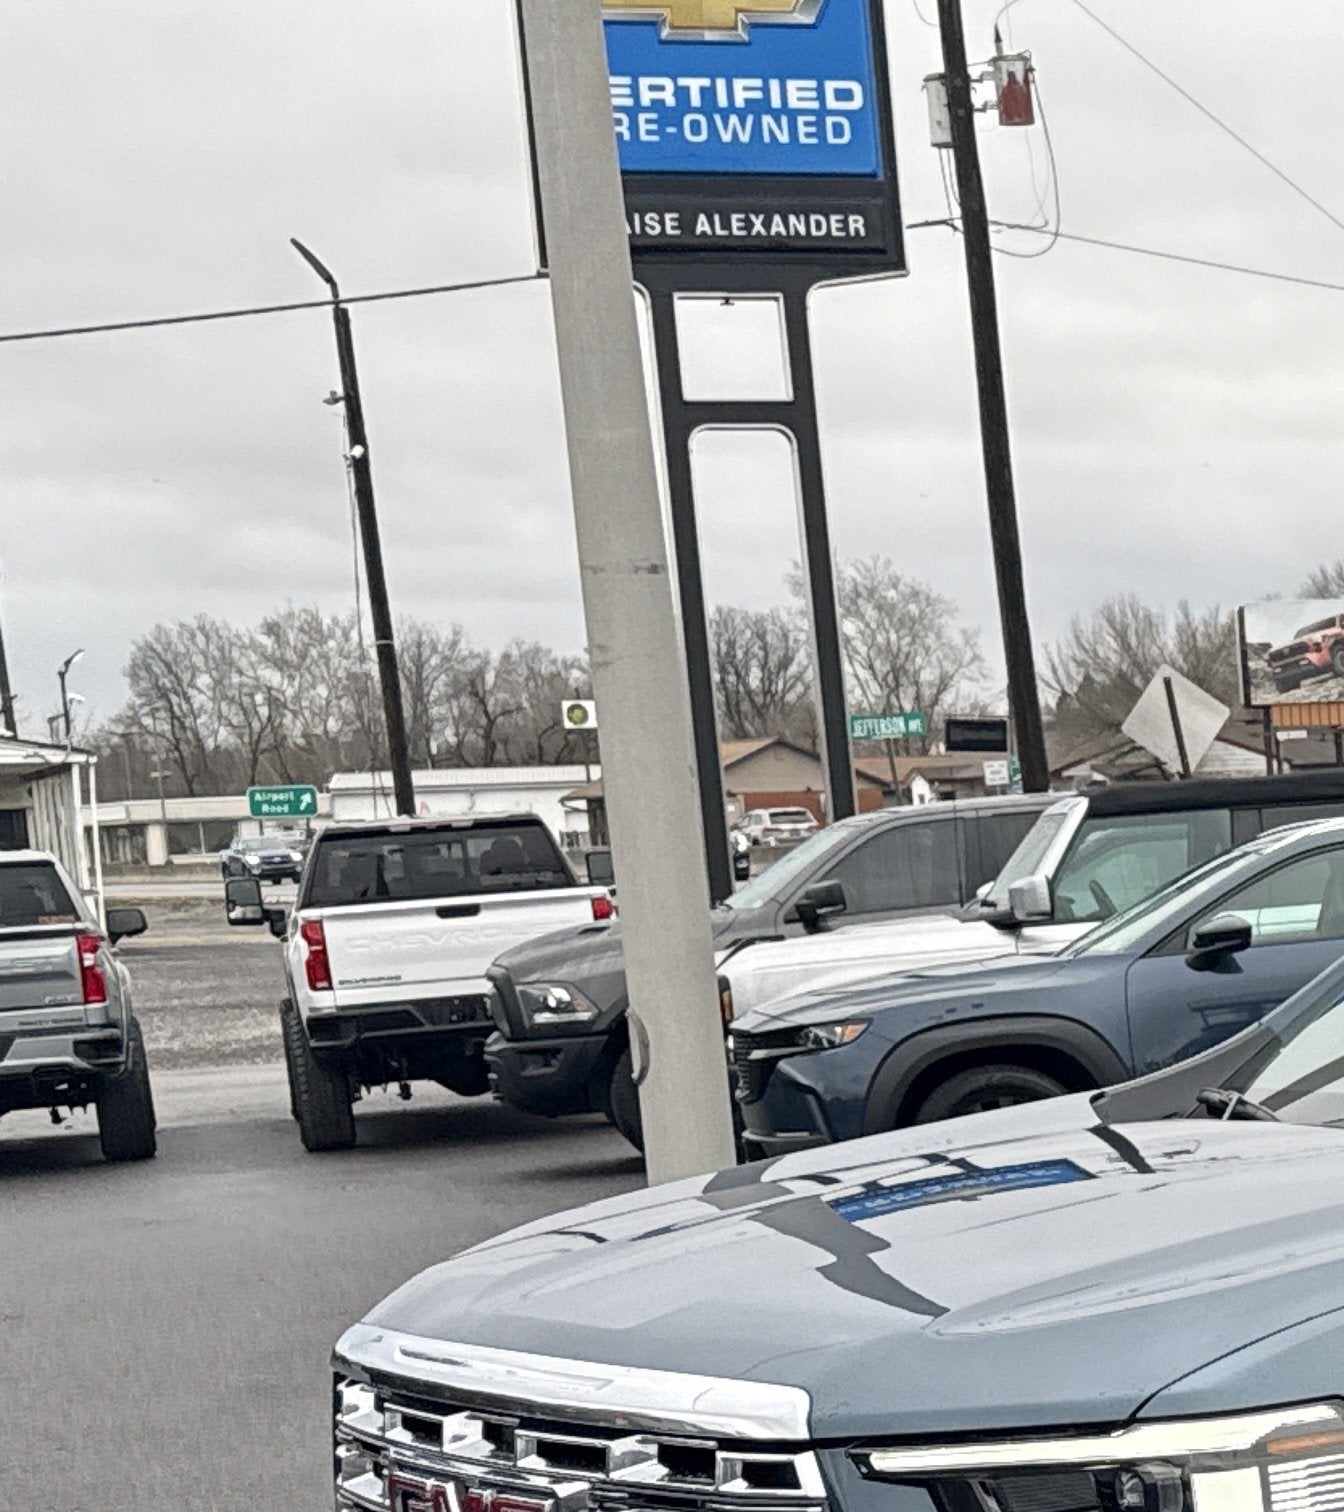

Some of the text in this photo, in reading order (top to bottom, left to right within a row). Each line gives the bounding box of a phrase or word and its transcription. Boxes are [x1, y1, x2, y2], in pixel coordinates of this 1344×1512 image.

[609, 76, 864, 110] ERTIFIED
[612, 112, 852, 144] RE-OWNED
[625, 212, 867, 238] ISE ALEXANDER
[254, 791, 294, 802] Airport
[261, 804, 289, 813] Road
